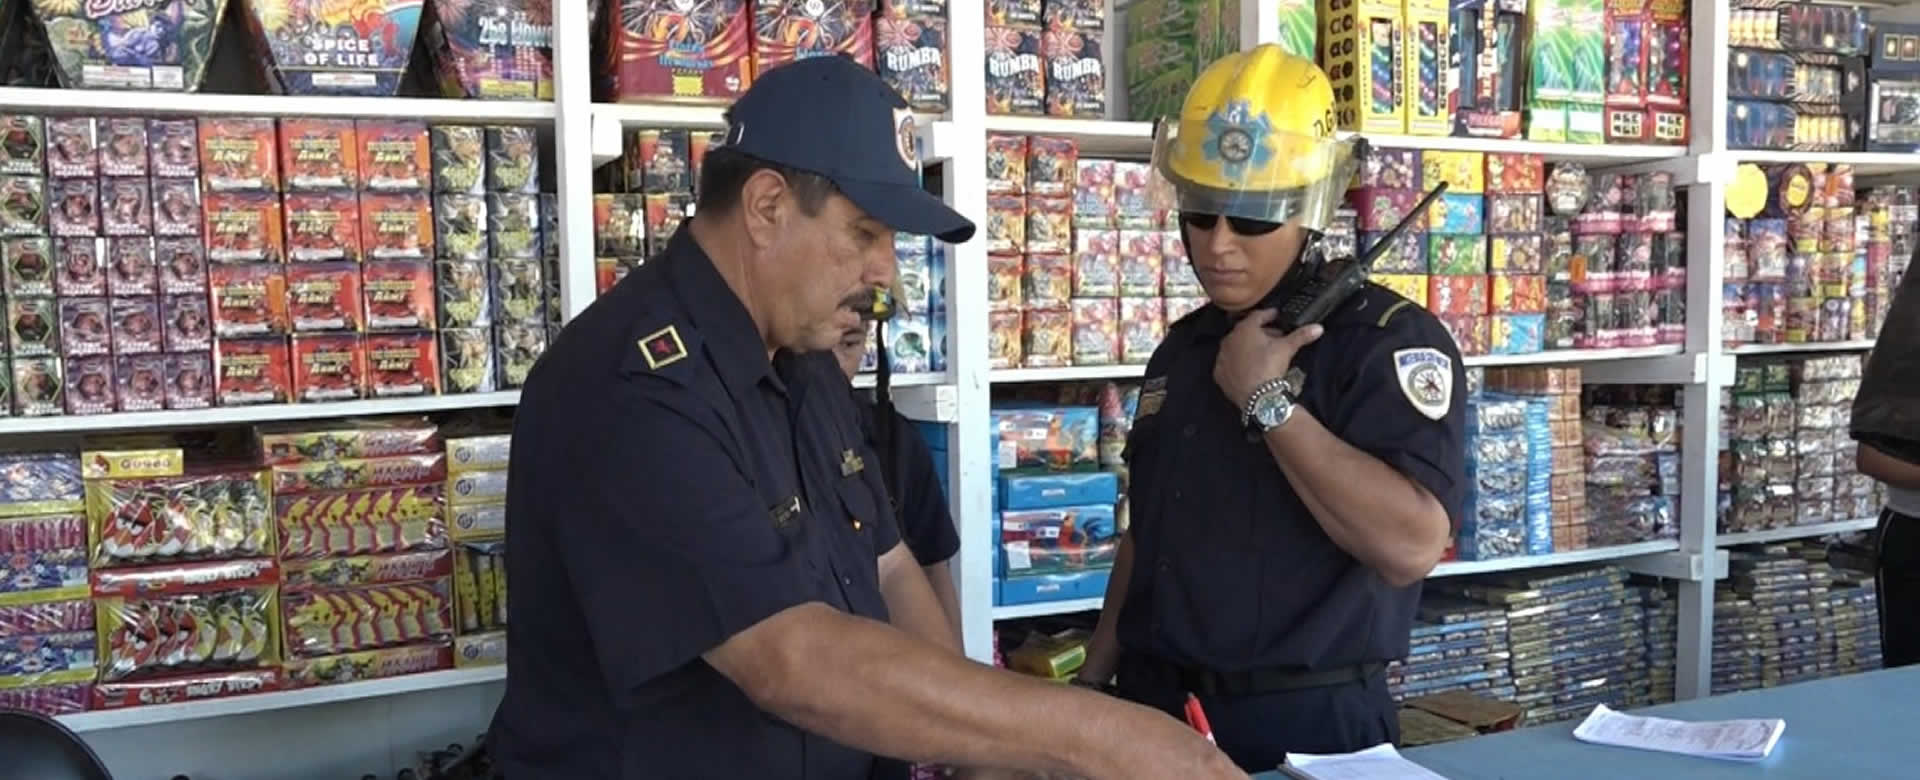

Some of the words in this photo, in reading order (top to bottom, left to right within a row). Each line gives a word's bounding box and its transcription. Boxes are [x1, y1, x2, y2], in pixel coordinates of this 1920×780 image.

[311, 38, 370, 52] SPICE
[304, 54, 330, 66] OF
[336, 54, 379, 67] LIFE
[886, 46, 942, 72] RUMBA
[989, 52, 1040, 77] RUMBA
[1053, 56, 1101, 81] RUMBA
